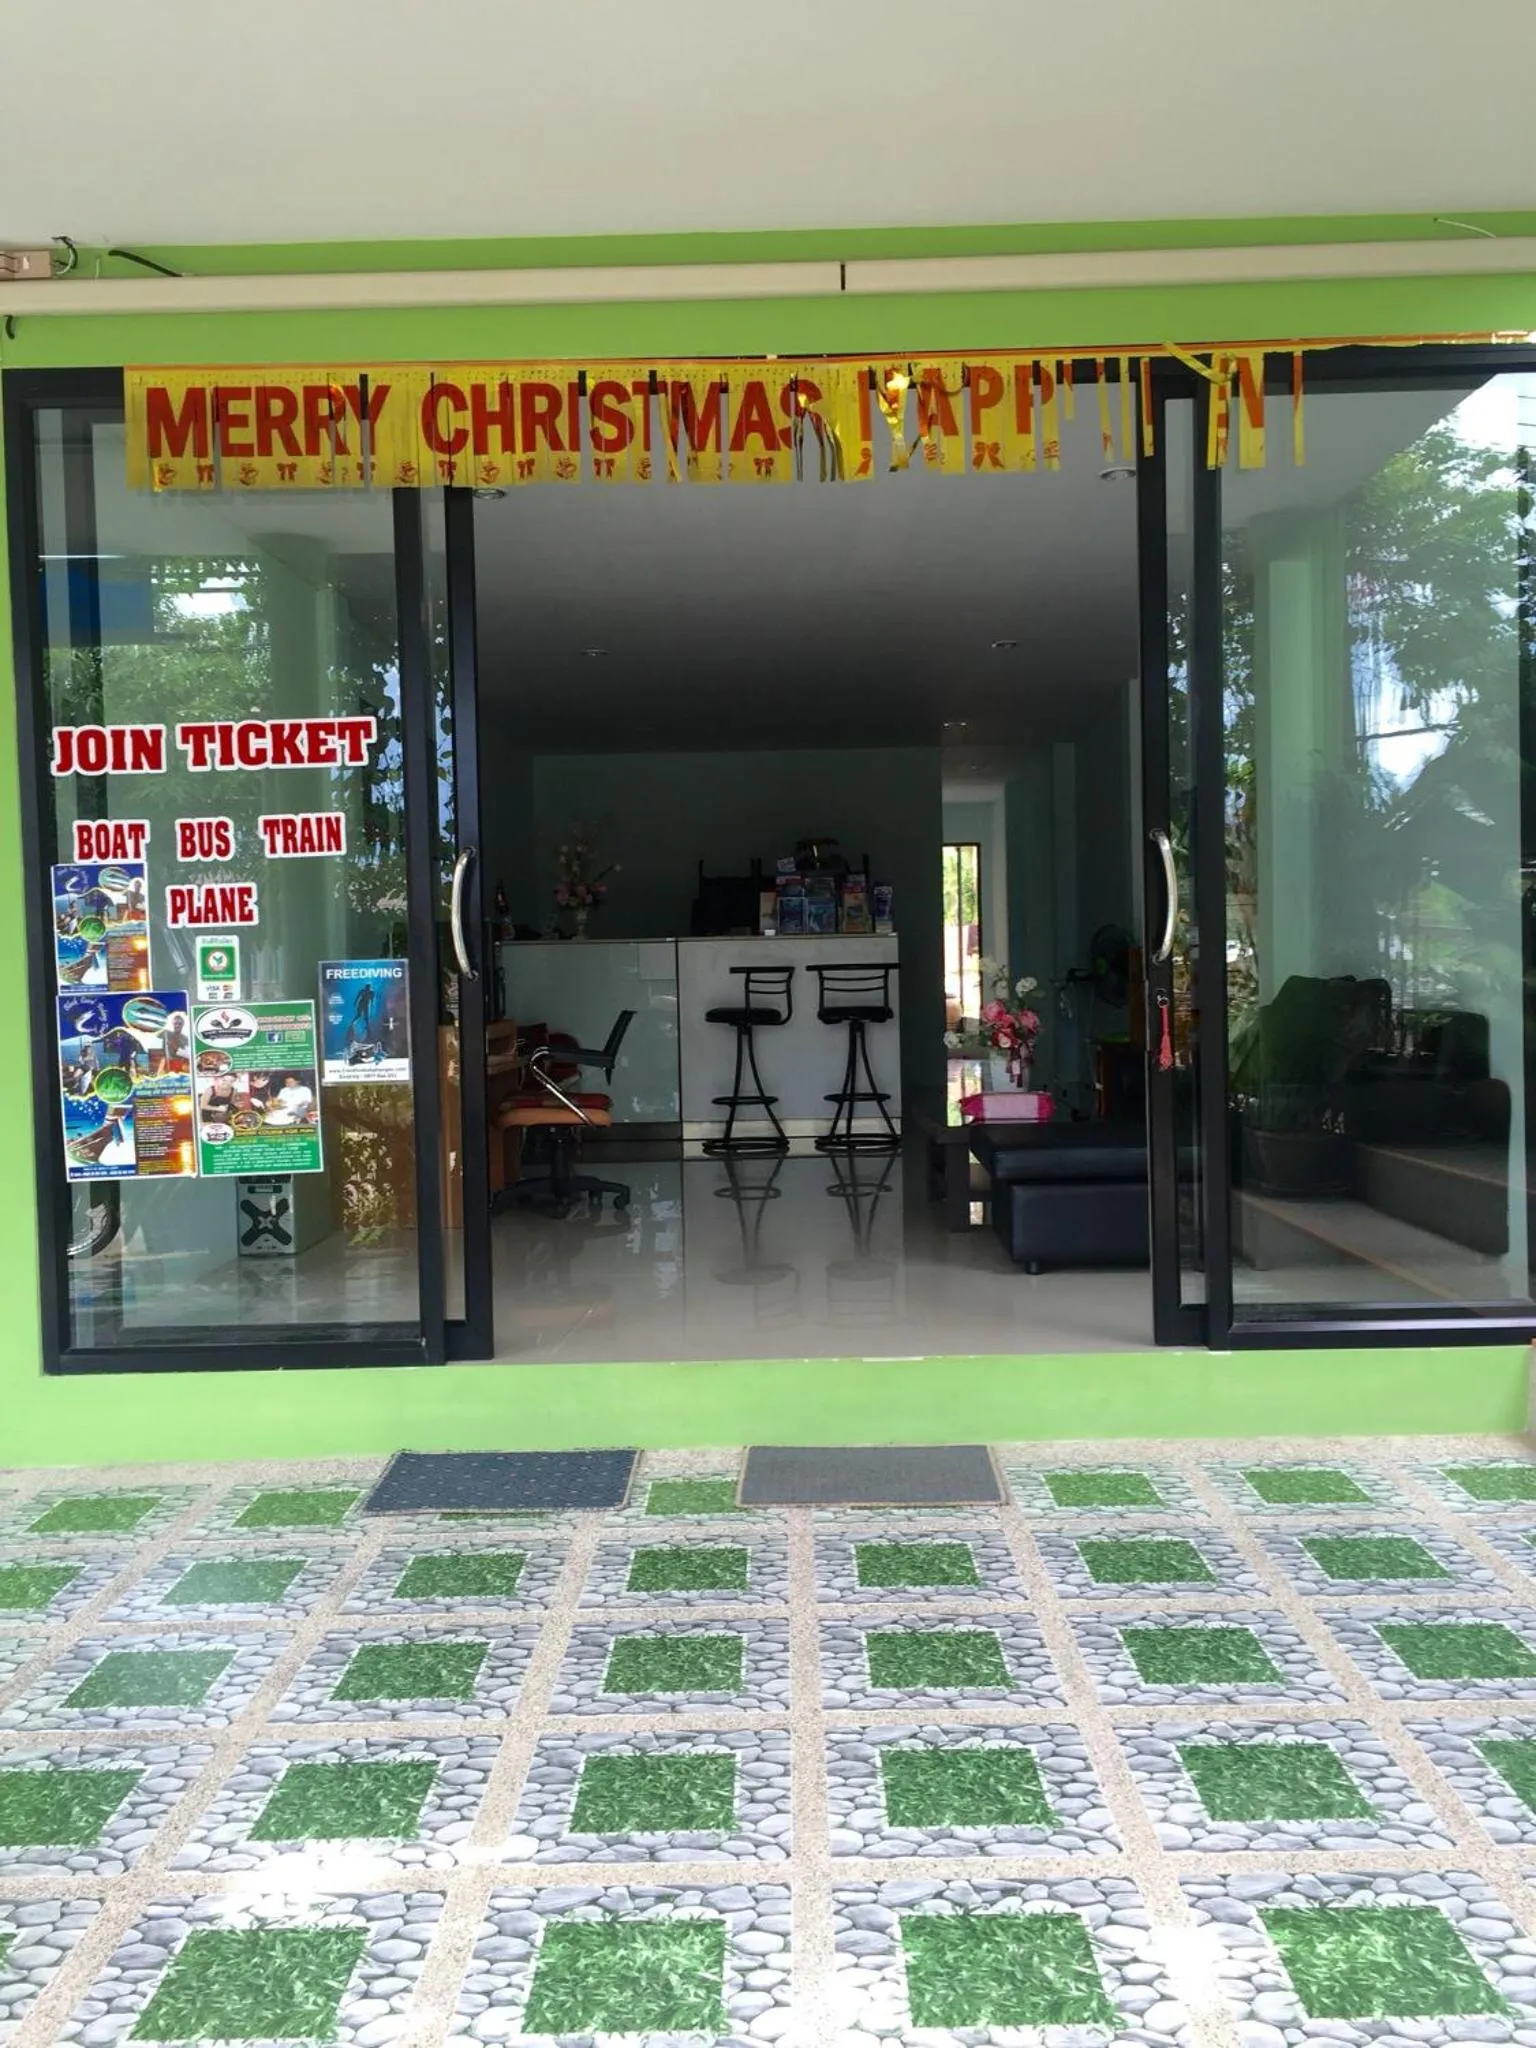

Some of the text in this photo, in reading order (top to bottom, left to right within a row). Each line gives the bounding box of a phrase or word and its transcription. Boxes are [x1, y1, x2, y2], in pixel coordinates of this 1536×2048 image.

[146, 384, 392, 459] MERRY
[55, 720, 373, 773] JOIN TICKET
[75, 816, 343, 860] BOAT BUS TRAIN
[169, 887, 255, 924] PLANE
[326, 967, 403, 979] FREEDIVING
